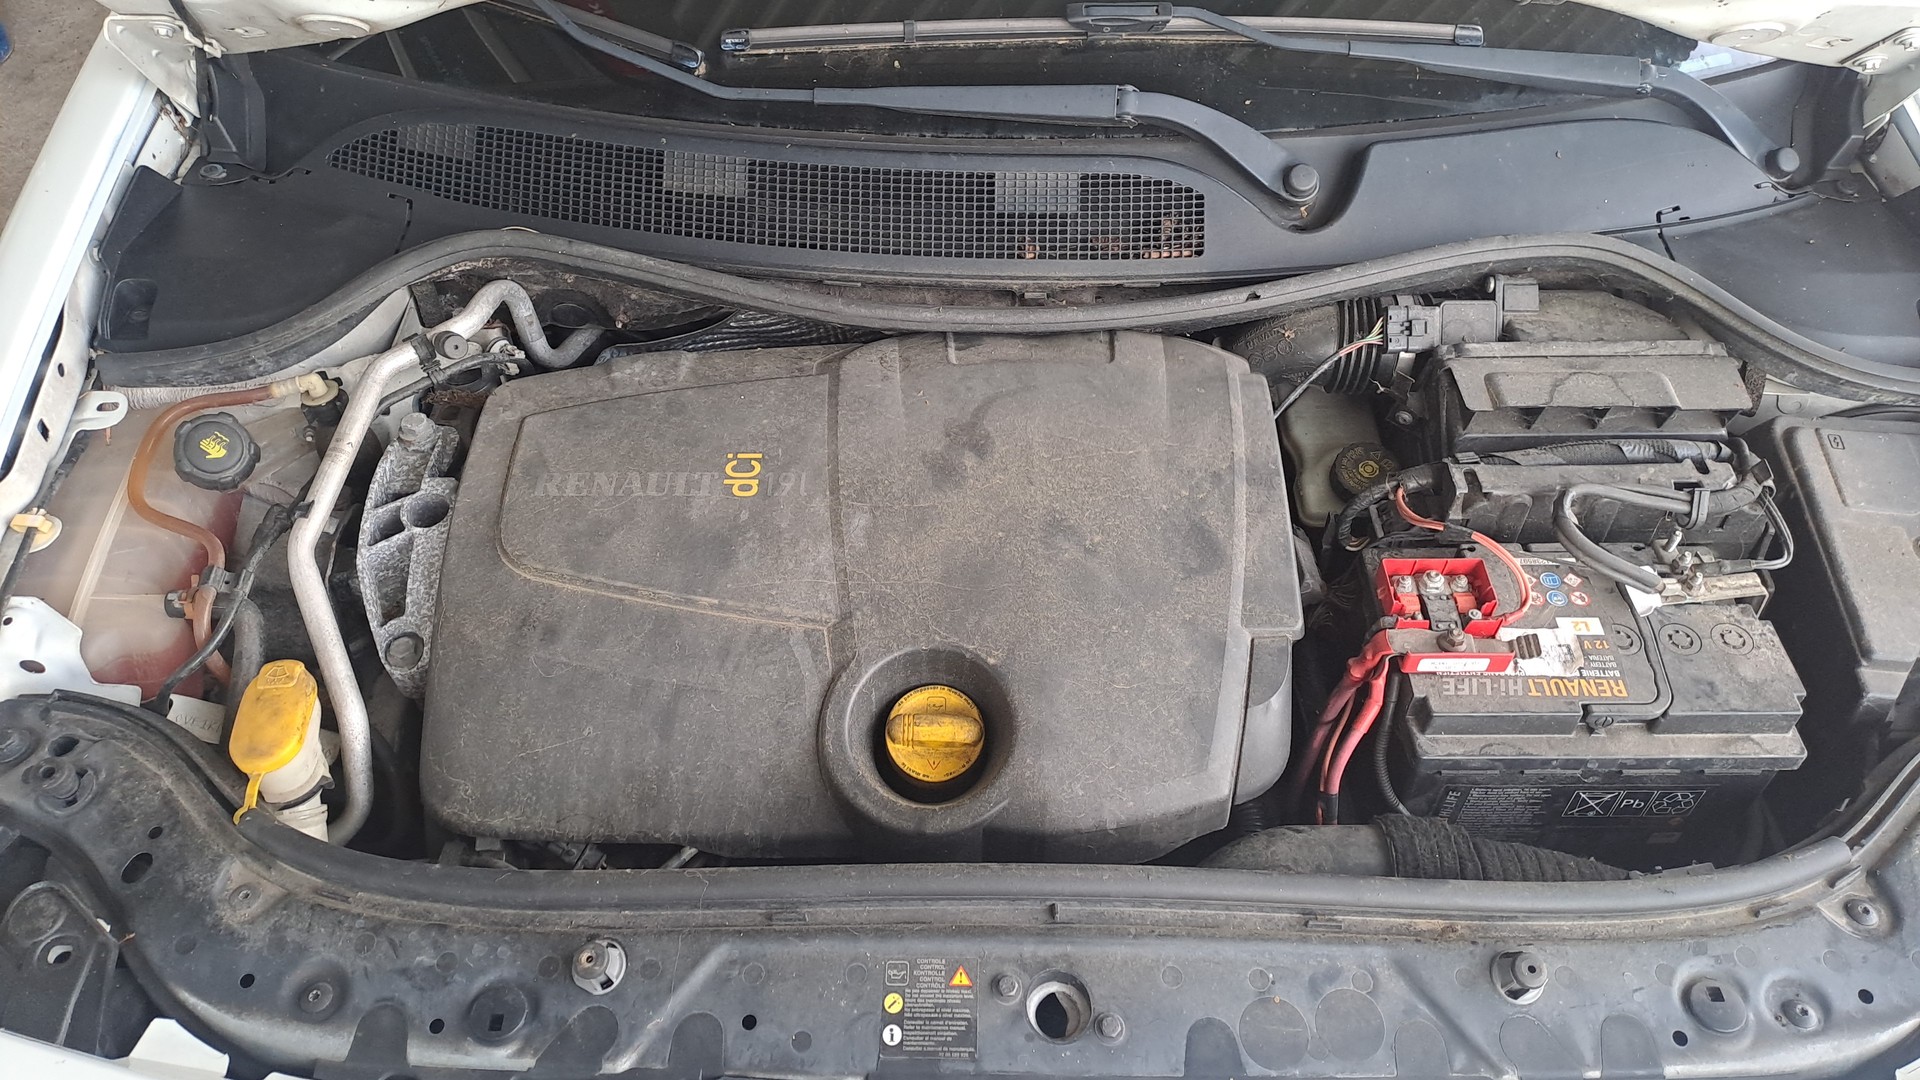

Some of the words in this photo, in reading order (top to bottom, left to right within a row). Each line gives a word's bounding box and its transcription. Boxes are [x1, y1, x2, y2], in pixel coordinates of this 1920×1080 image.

[723, 453, 763, 497] dCi
[530, 471, 719, 497] RENAULT
[1571, 621, 1591, 632] L2
[1583, 640, 1592, 649] V
[1595, 640, 1610, 649] 12
[1582, 669, 1621, 677] BATTERIE
[1442, 678, 1523, 696] Hi-LIFE
[1527, 678, 1629, 697] RENAULT
[1620, 799, 1645, 809] Pb
